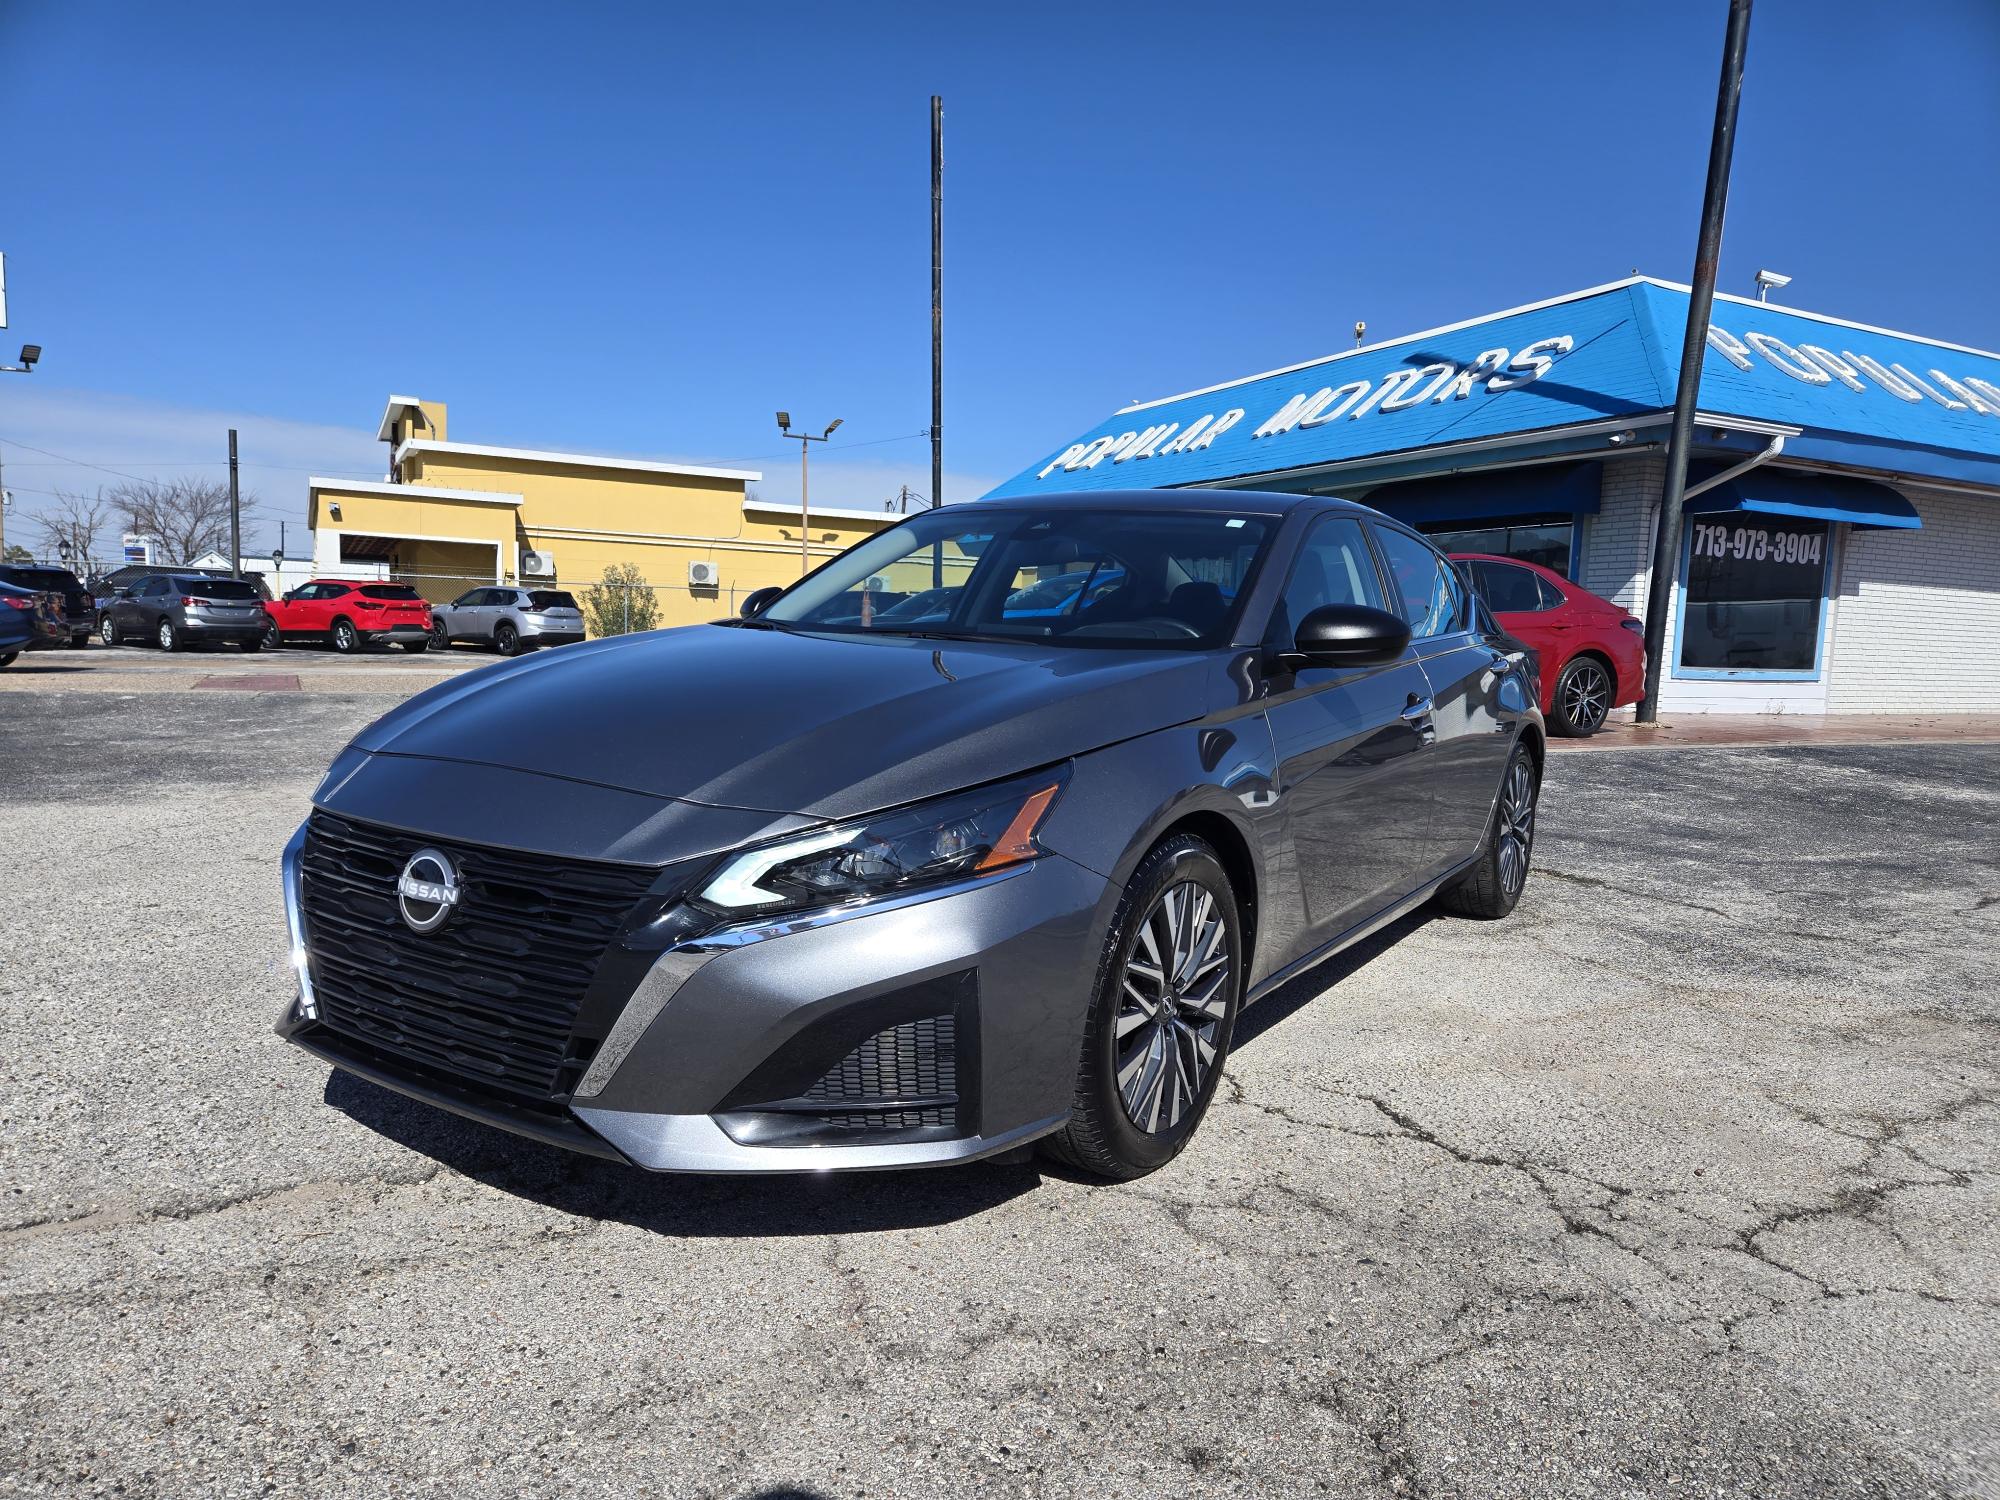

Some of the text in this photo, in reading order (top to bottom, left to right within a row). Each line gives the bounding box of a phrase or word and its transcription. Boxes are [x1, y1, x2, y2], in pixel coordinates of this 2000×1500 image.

[1037, 335, 1574, 479] POPULAR MOTORS
[1695, 525, 1821, 565] 713-973-3904
[399, 878, 456, 902] NISSAN
